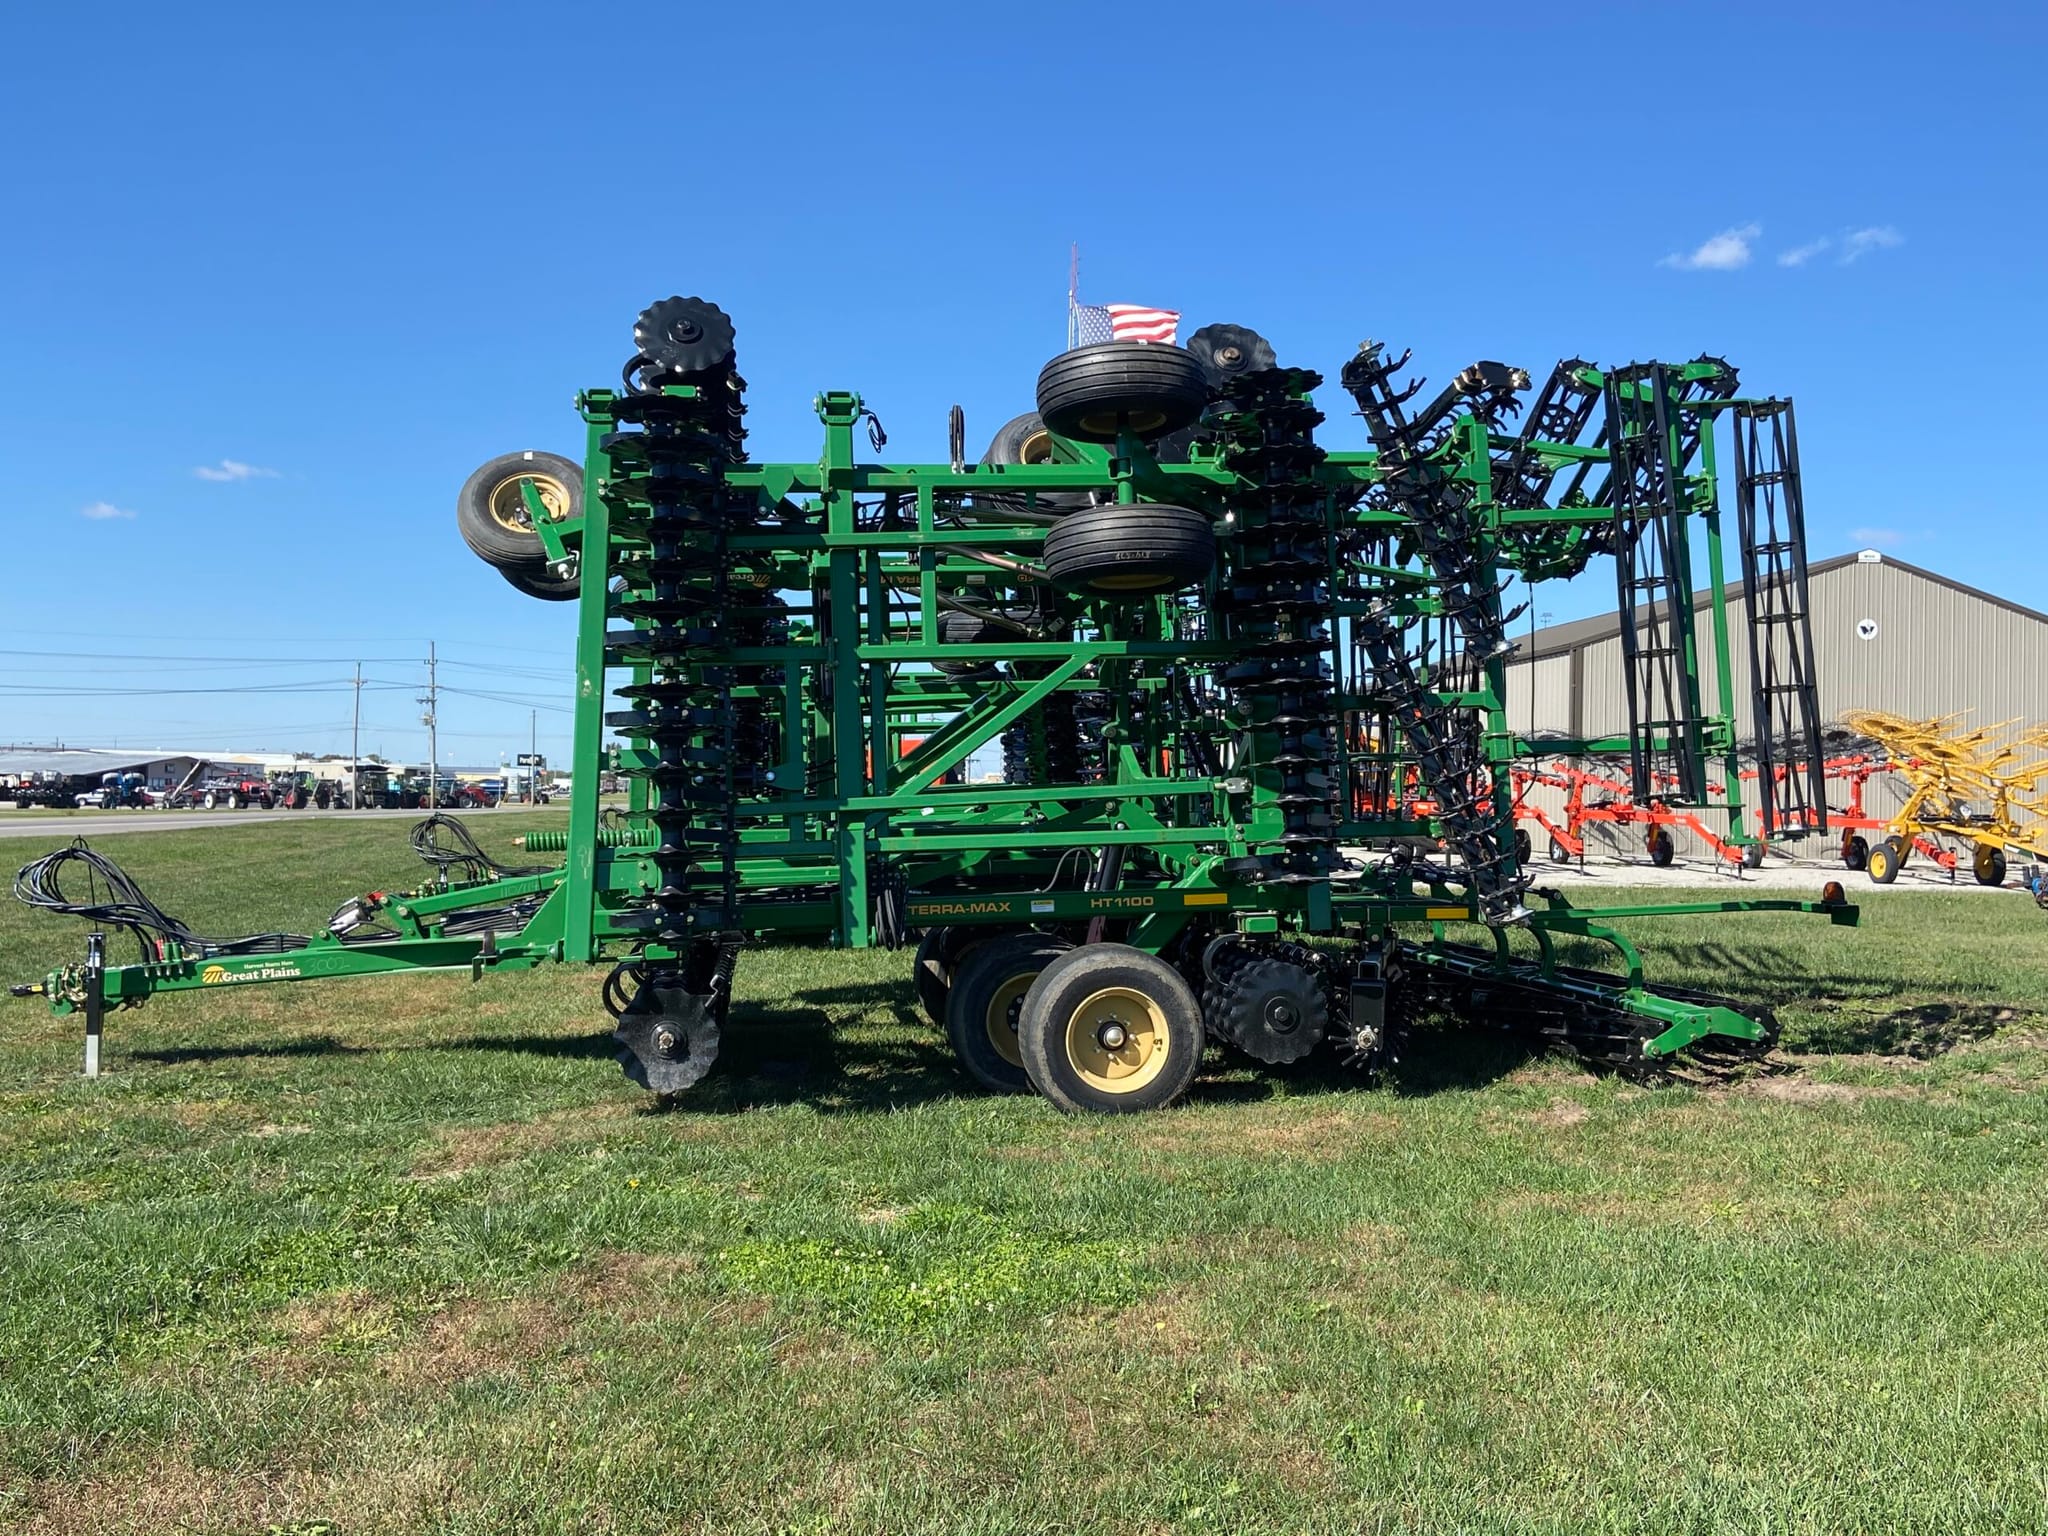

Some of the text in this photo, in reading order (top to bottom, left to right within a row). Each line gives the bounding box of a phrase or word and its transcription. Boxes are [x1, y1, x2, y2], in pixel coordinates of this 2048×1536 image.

[907, 902, 1011, 915] TERRA-MAX
[1090, 896, 1154, 908] HT1100
[222, 967, 301, 982] Great Plains
